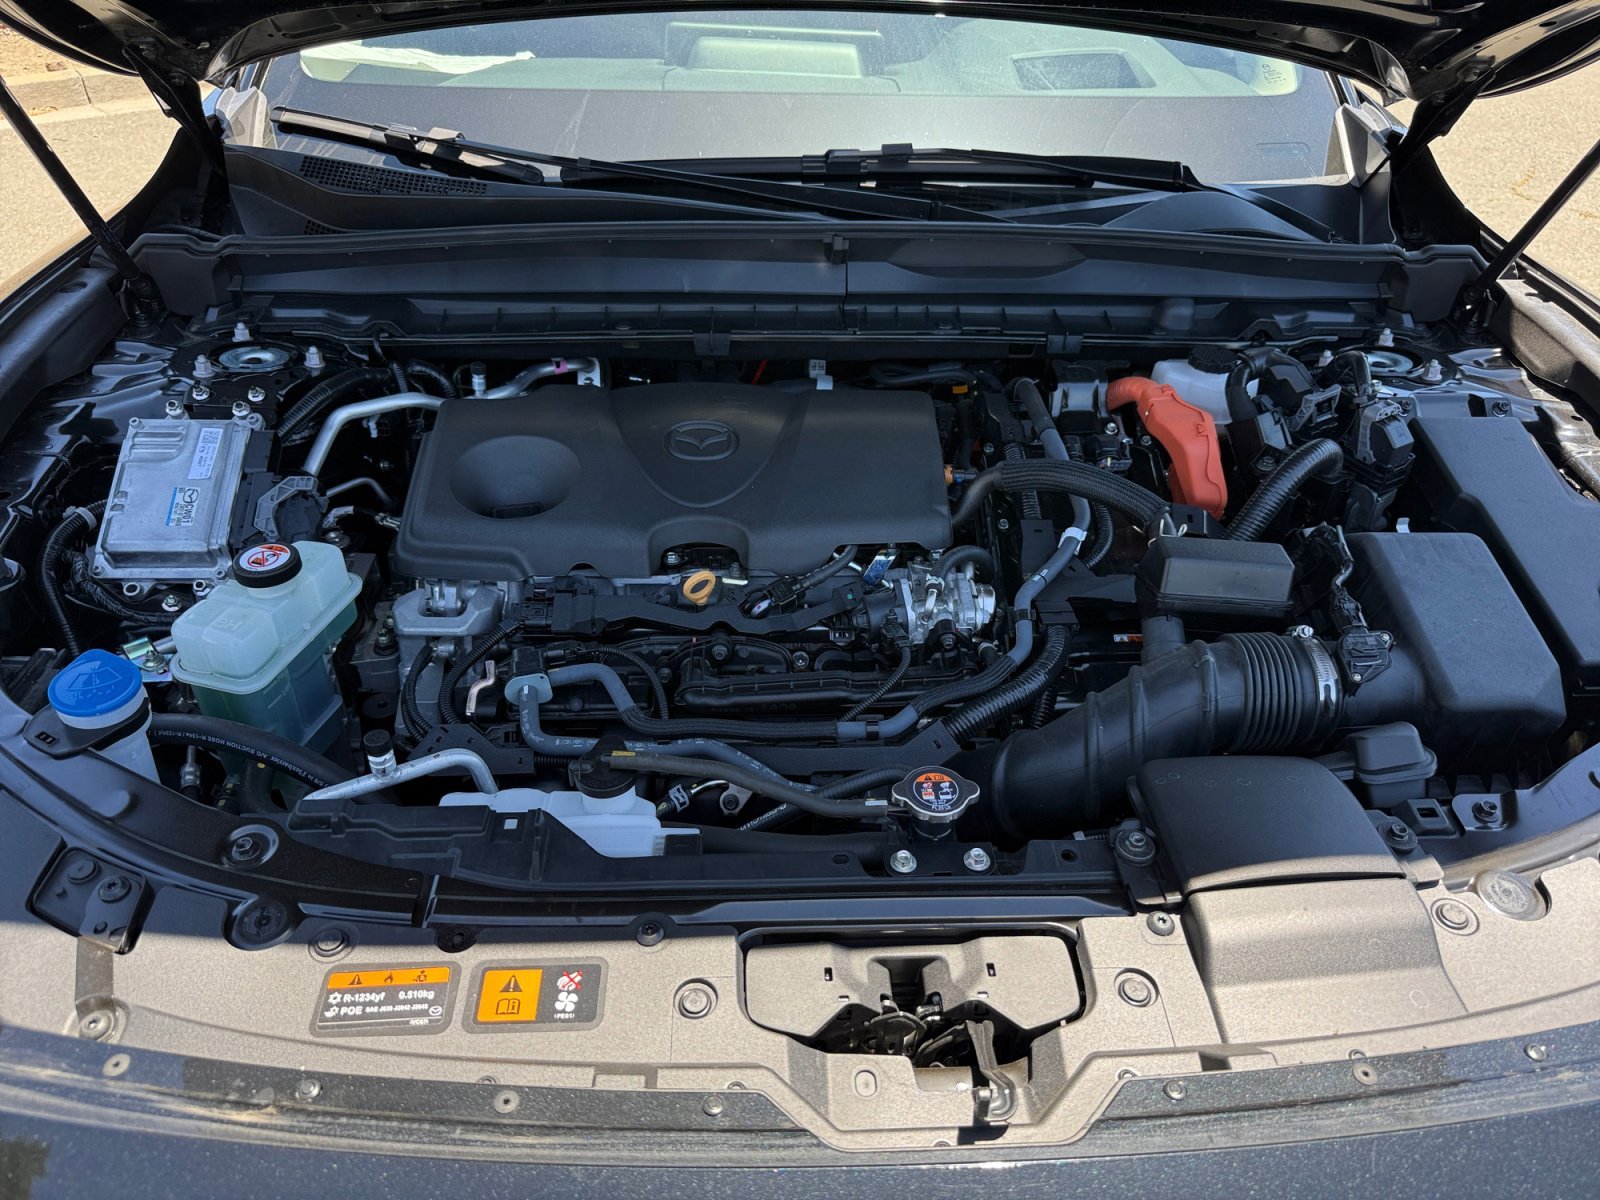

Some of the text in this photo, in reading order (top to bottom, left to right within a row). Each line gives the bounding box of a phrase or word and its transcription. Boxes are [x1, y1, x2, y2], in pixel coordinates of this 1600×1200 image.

[207, 735, 225, 745] HOSE
[225, 740, 256, 755] SUCTION
[343, 989, 435, 1003] R-1234yf 0.510kg
[340, 1006, 363, 1016] POE
